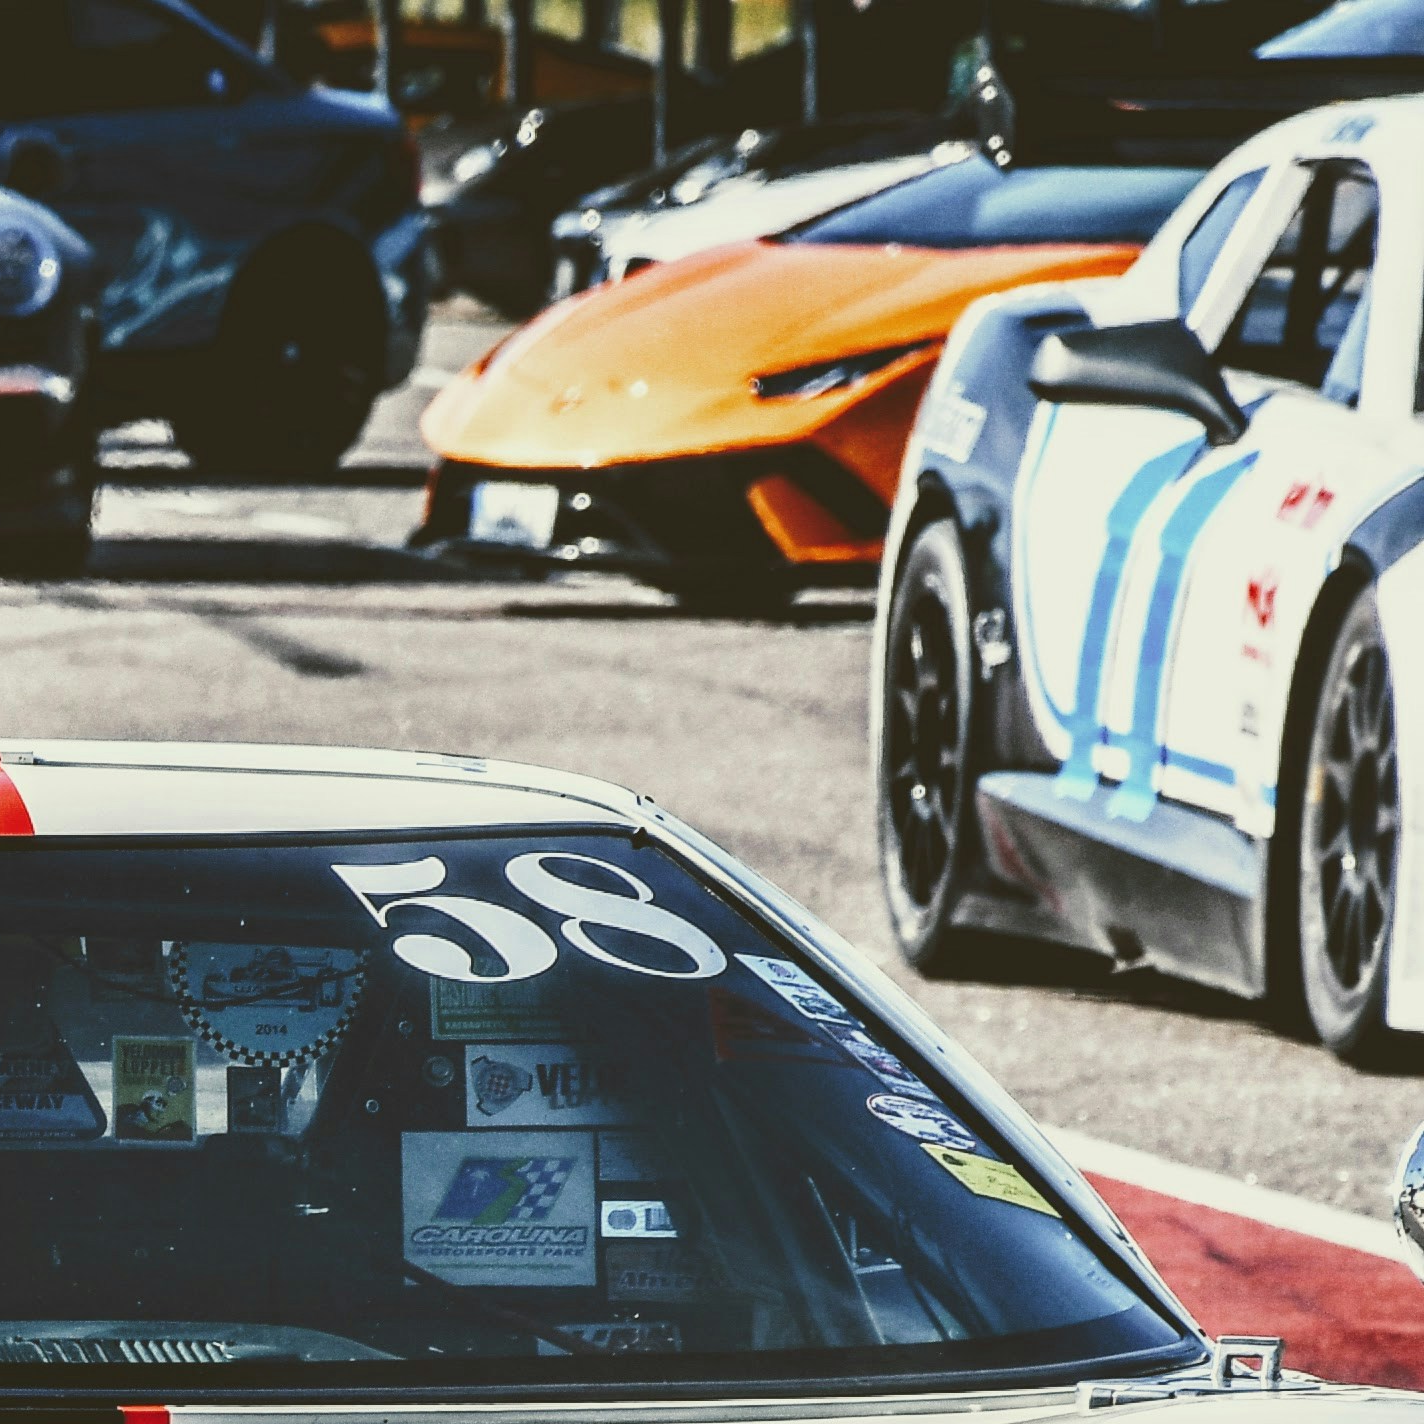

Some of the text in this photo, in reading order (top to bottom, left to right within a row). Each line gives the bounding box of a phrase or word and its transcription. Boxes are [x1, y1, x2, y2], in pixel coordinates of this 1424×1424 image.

[330, 851, 728, 984] 58
[255, 1025, 288, 1036] 2014
[414, 1227, 587, 1244] CAROLINA
